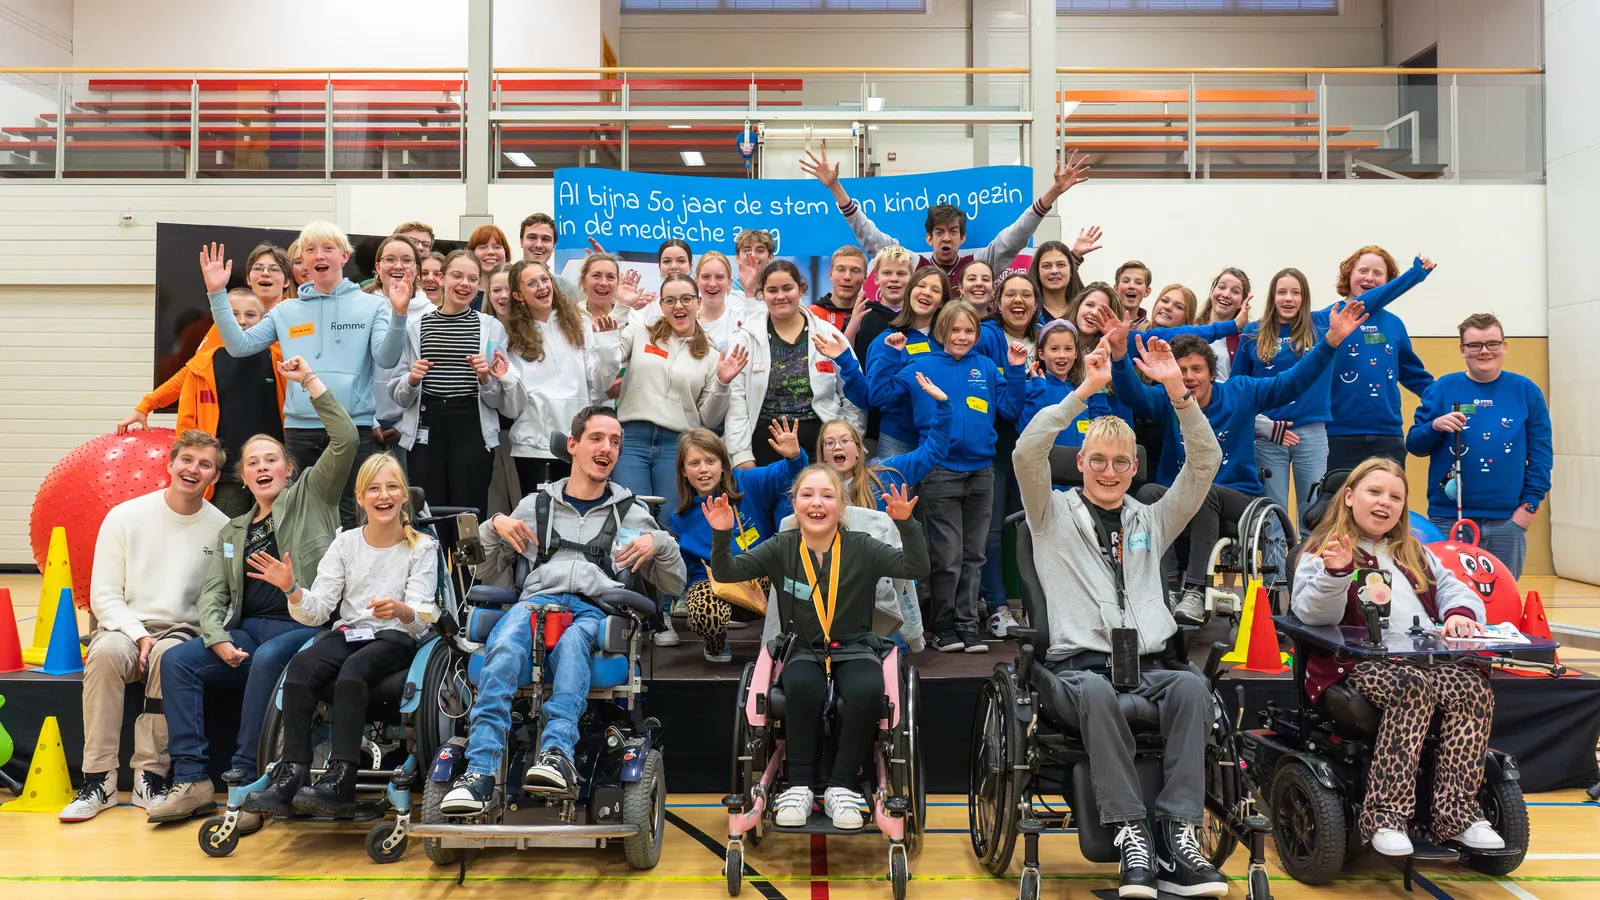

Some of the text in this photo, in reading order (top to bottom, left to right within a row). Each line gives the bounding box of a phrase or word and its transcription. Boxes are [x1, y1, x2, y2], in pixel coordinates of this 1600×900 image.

[559, 181, 579, 206] Al
[587, 185, 640, 219] bijna
[647, 190, 674, 211] 50
[677, 194, 727, 224] jaar
[734, 192, 763, 215] de
[769, 196, 829, 216] stem
[884, 187, 930, 212] kind
[936, 193, 960, 207] en
[966, 182, 1023, 220] gezin
[559, 215, 576, 236] in
[584, 214, 614, 236] de
[620, 218, 726, 242] medische
[330, 321, 366, 331] Romme
